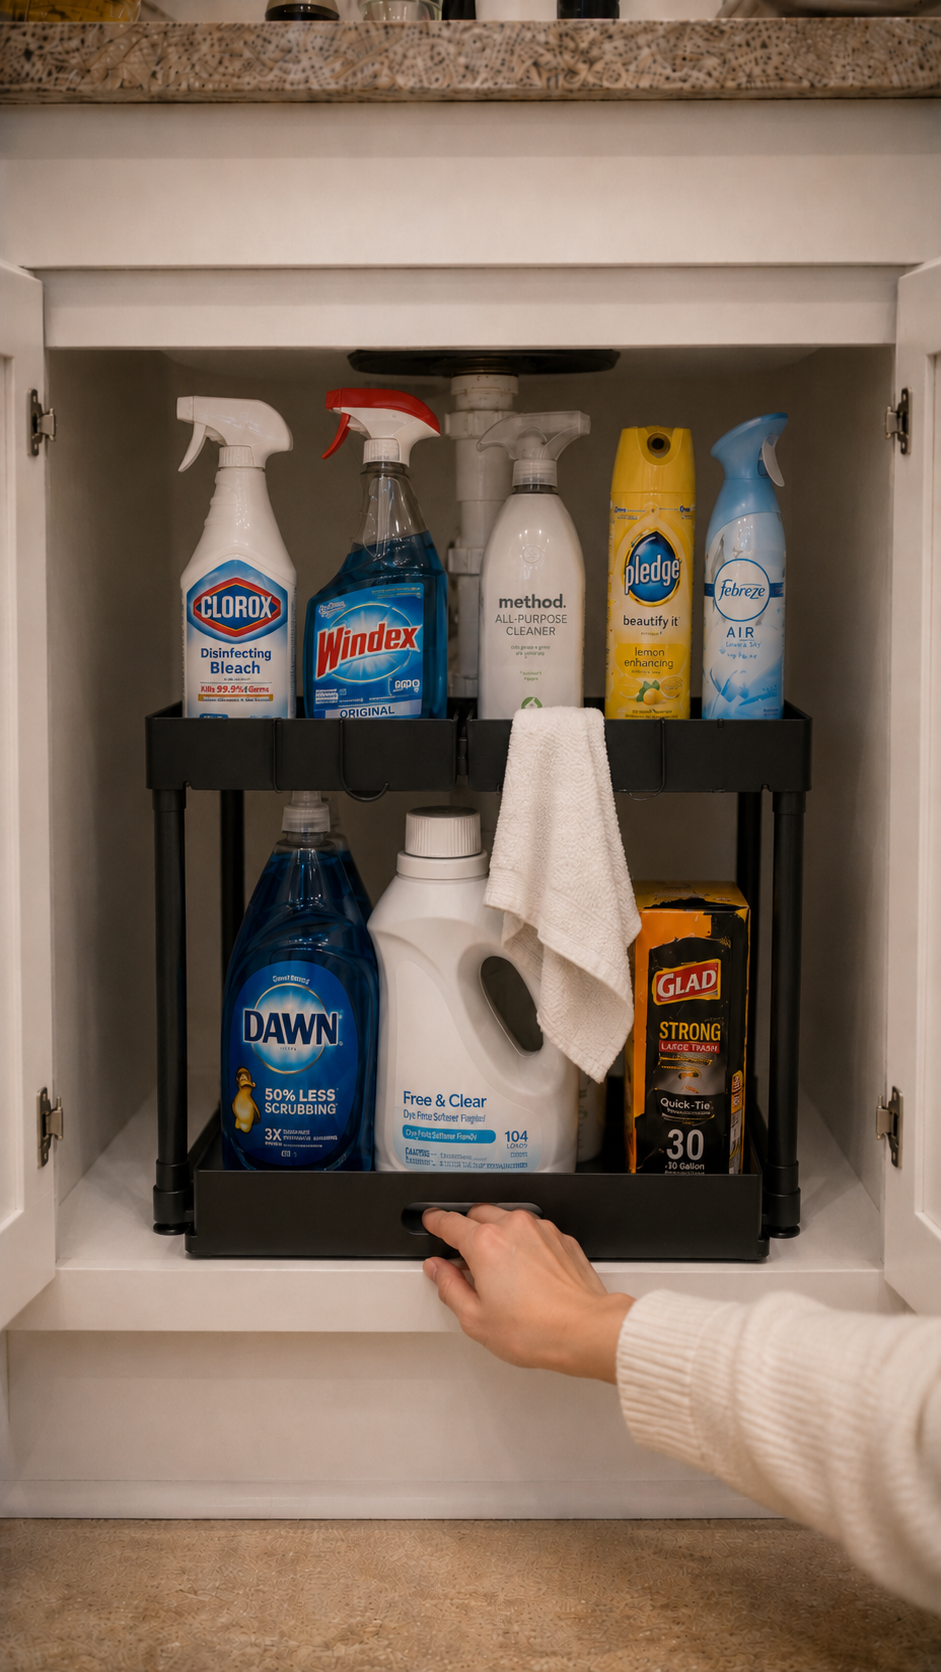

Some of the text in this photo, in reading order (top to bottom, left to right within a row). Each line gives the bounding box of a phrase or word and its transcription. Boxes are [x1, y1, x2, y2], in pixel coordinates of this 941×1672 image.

[624, 554, 680, 596] pledge
[717, 579, 766, 602] febreze
[200, 595, 272, 619] CLOROX
[499, 593, 567, 609] method.
[494, 614, 568, 624] ALL-PURPOSE
[623, 615, 679, 630] beautify it
[505, 626, 556, 636] CLEANER
[726, 626, 755, 638] AIR
[200, 647, 272, 661] Disinfecting
[315, 621, 423, 680] Windex
[634, 647, 665, 657] lemon
[210, 660, 261, 674] Bleach
[624, 658, 674, 670] enhancing
[339, 705, 395, 719] ORIGINAL
[657, 969, 717, 998] GLAD
[243, 1008, 339, 1047] DAWN
[659, 1021, 721, 1041] STRONG
[265, 1088, 336, 1102] 50% LESS
[403, 1090, 488, 1108] Free & Clear
[264, 1102, 337, 1115] SCRUBBING
[660, 1097, 711, 1110] Quick-Tie
[264, 1128, 282, 1141] 3X
[504, 1130, 529, 1143] 104
[666, 1128, 705, 1161] 30
[679, 1162, 705, 1171] Gallon
